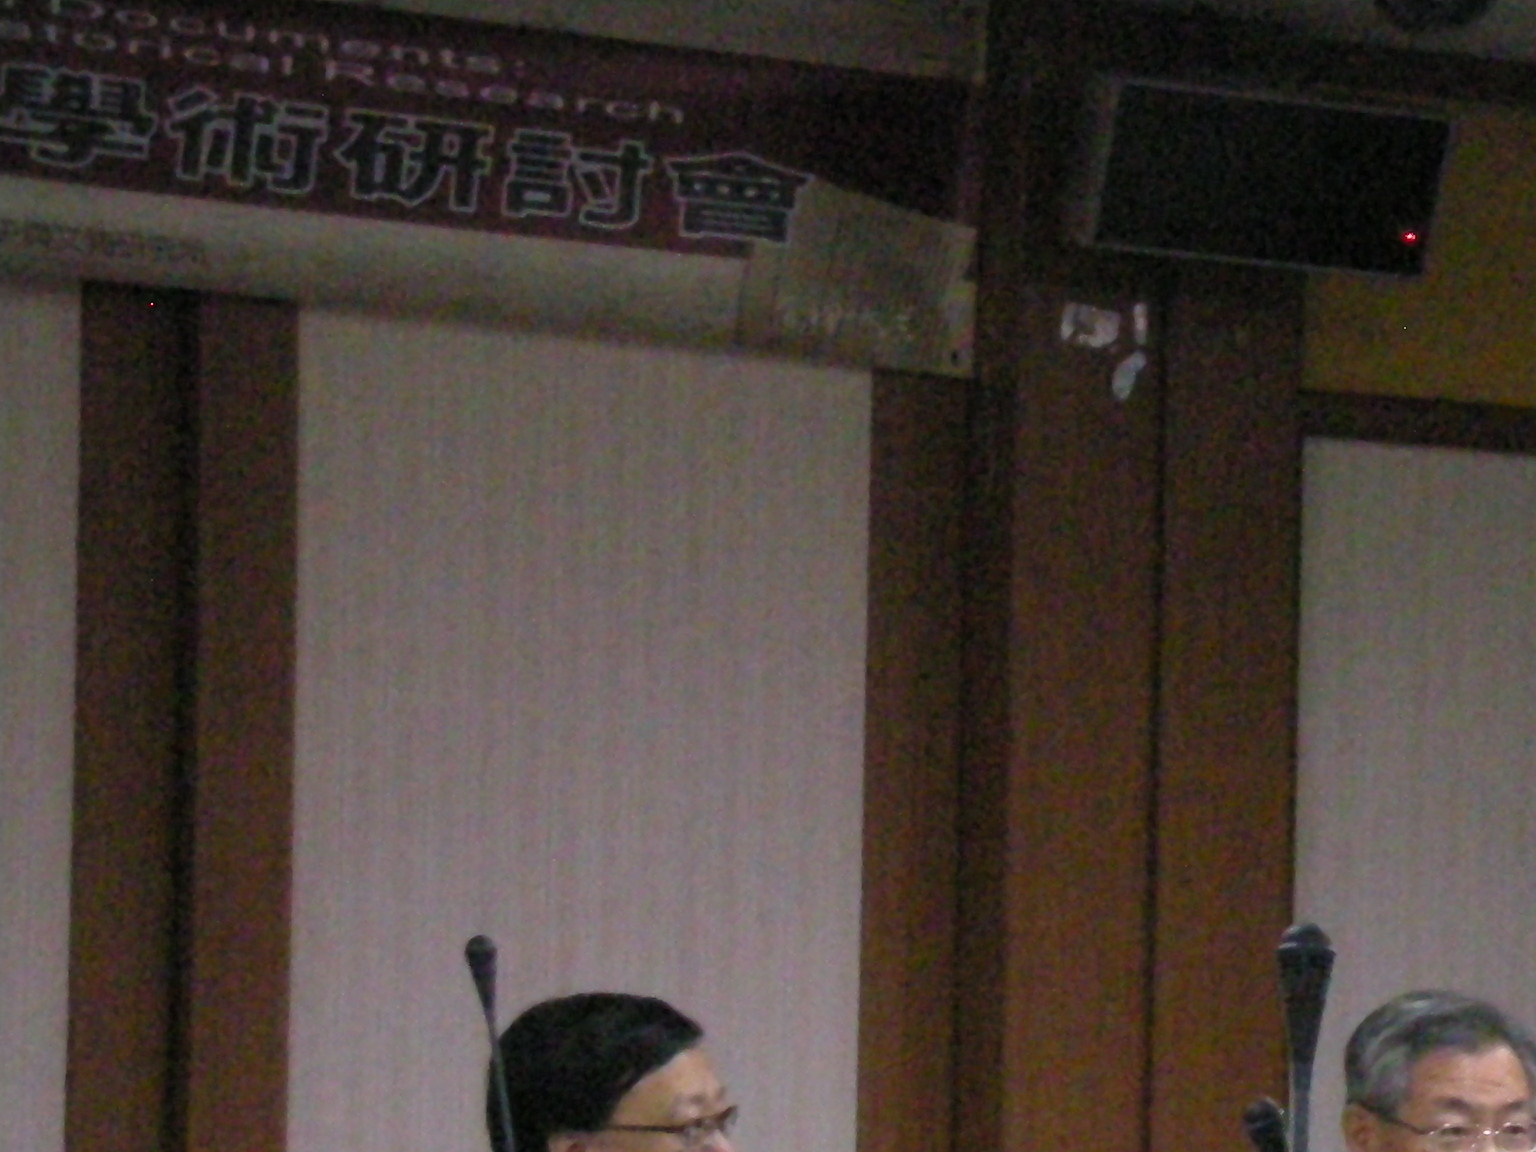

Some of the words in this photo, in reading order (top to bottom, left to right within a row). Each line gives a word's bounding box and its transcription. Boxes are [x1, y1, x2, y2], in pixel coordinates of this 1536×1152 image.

[0, 62, 815, 245] 學術研討會
